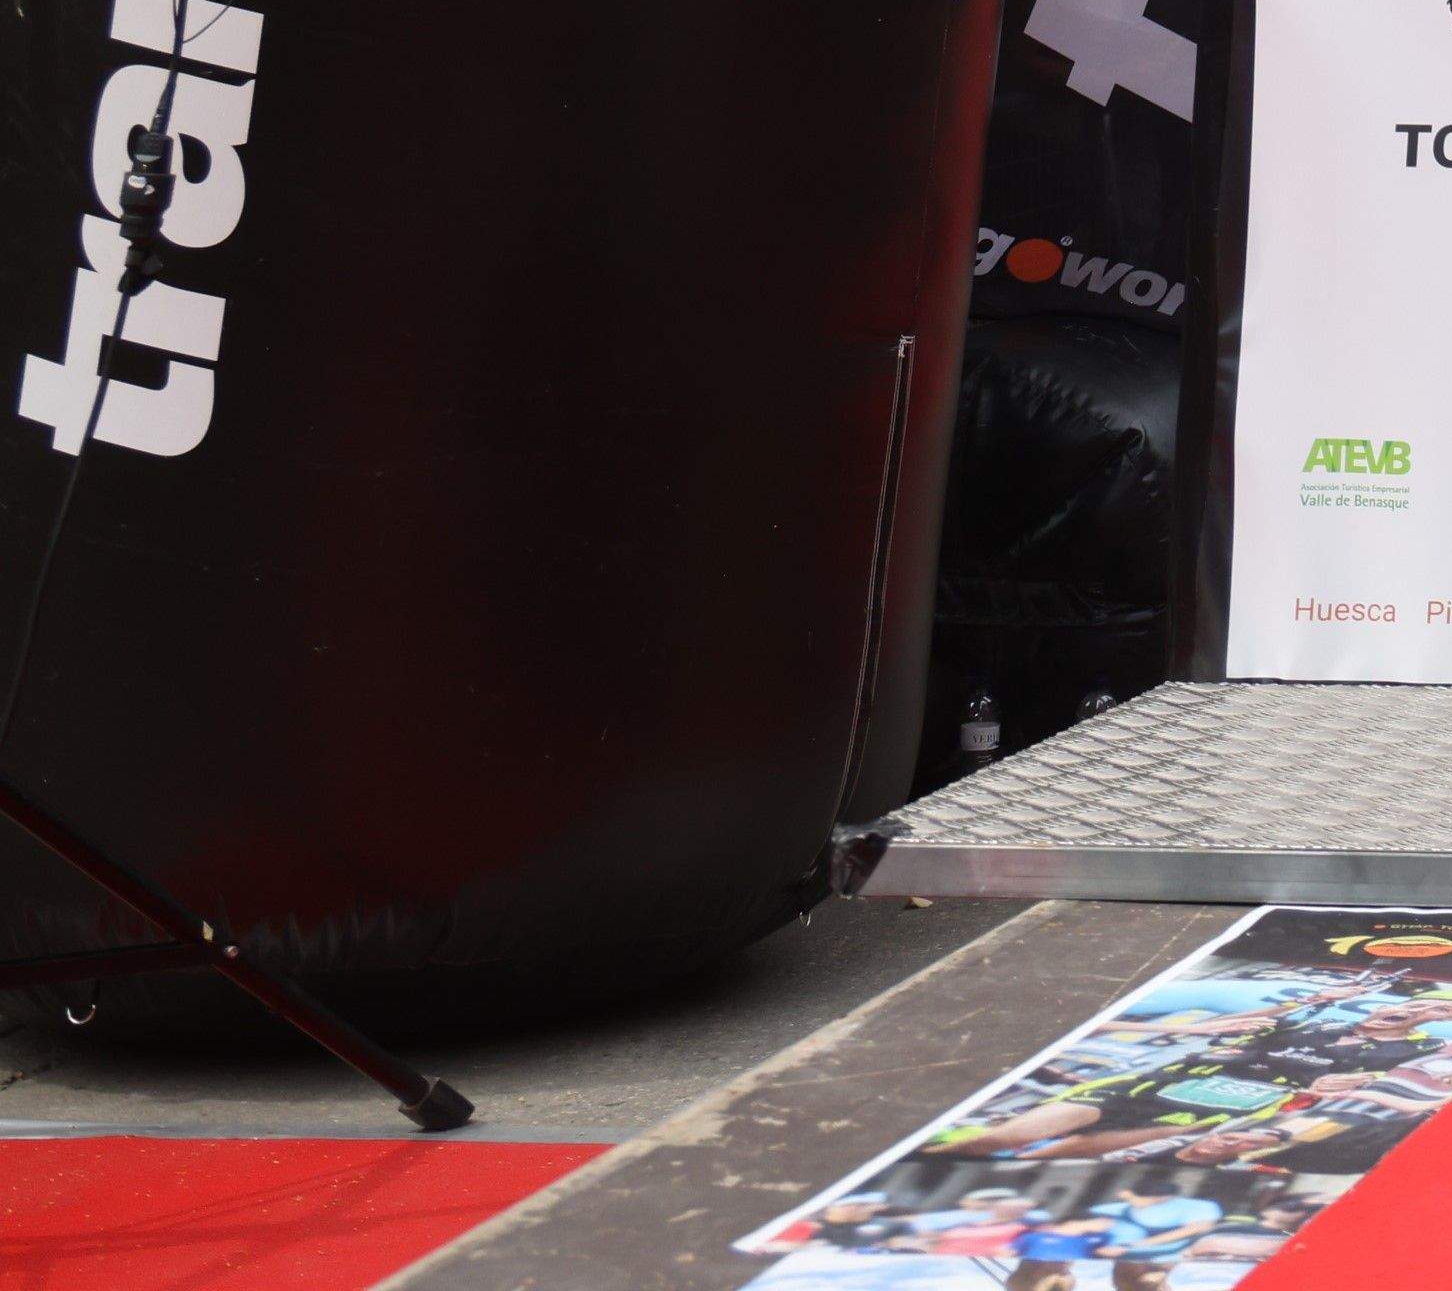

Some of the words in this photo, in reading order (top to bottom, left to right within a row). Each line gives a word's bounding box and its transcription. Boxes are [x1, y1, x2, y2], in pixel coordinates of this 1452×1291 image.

[1301, 438, 1412, 475] ATEVB
[1301, 494, 1329, 507] Valle
[1333, 494, 1350, 507] de
[1354, 495, 1409, 511] Benasque
[1294, 598, 1397, 623] Huesca
